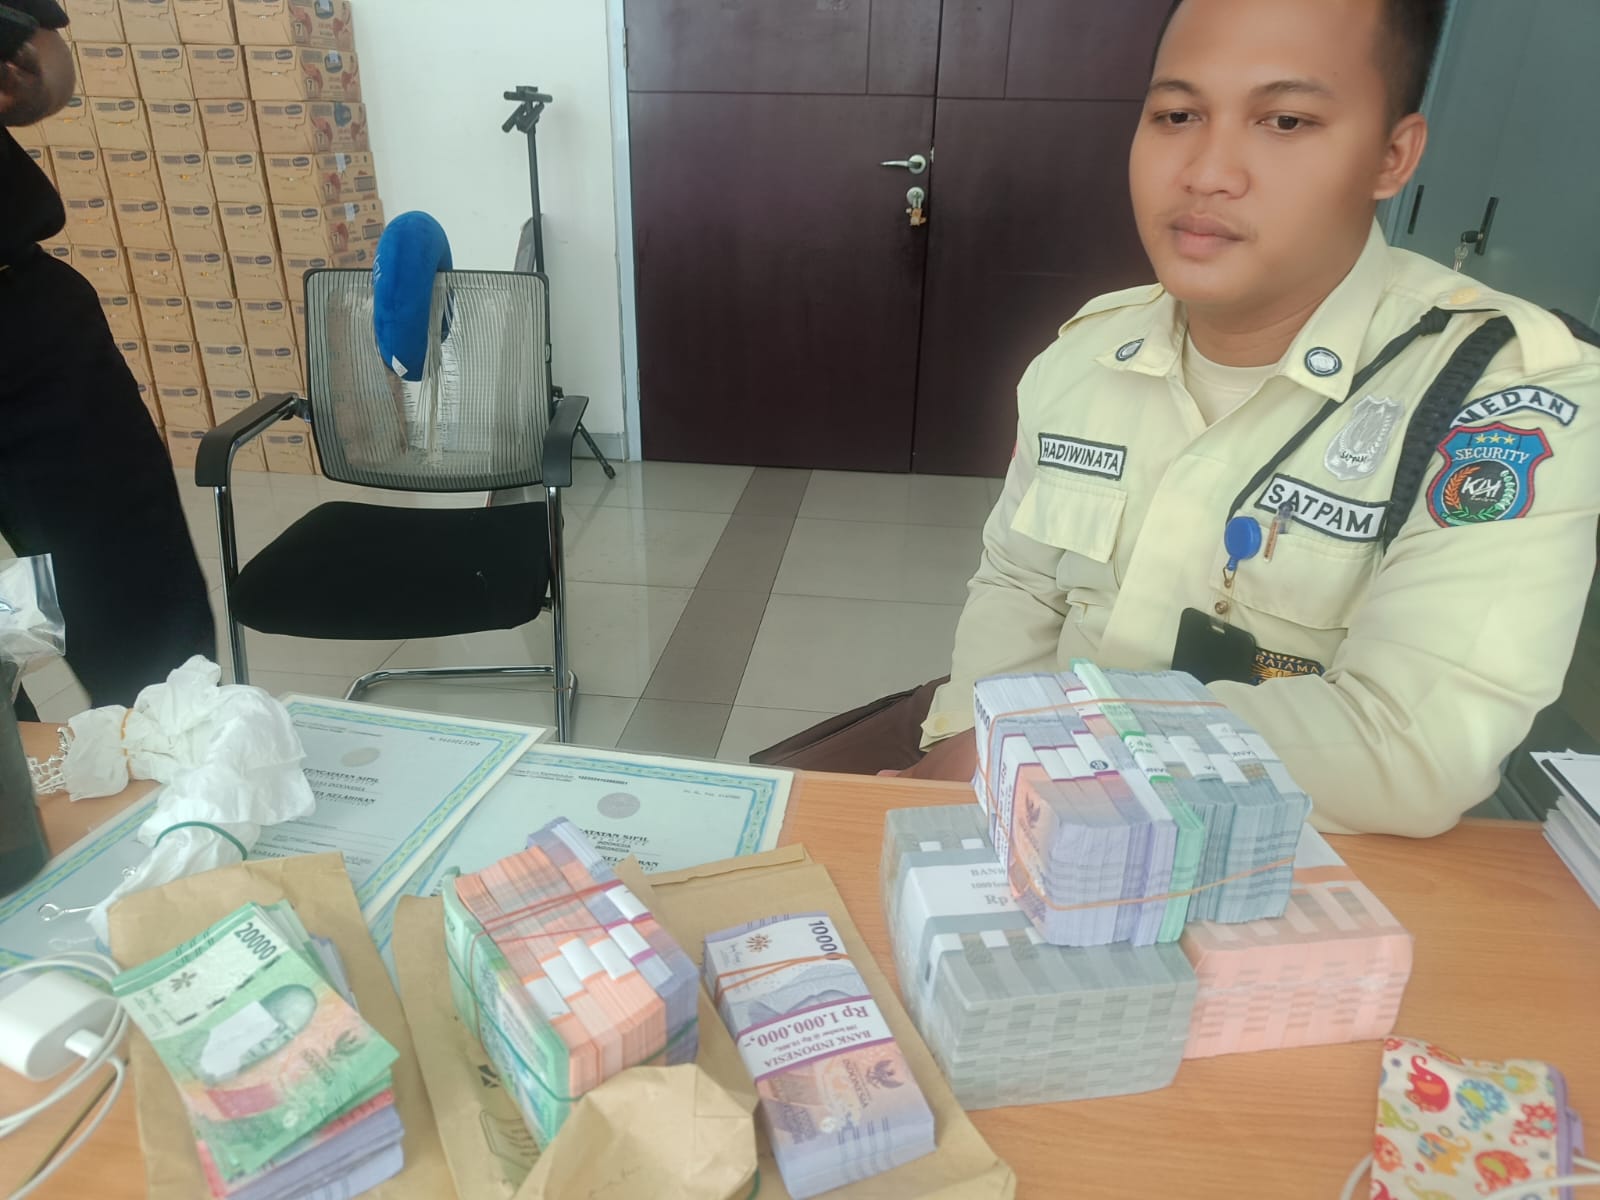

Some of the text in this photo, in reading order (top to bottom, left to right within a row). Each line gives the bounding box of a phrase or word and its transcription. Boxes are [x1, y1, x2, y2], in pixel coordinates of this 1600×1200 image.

[1457, 391, 1565, 424] MEDAN
[1042, 441, 1119, 473] HADIWINATA
[1455, 447, 1530, 464] SECURITY
[1268, 483, 1374, 534] SATPAM
[984, 894, 1009, 906] Rp
[234, 922, 277, 961] 20000
[743, 1005, 869, 1048] Rp 1.000.000,-
[763, 1029, 872, 1067] BANK INDONESIA
